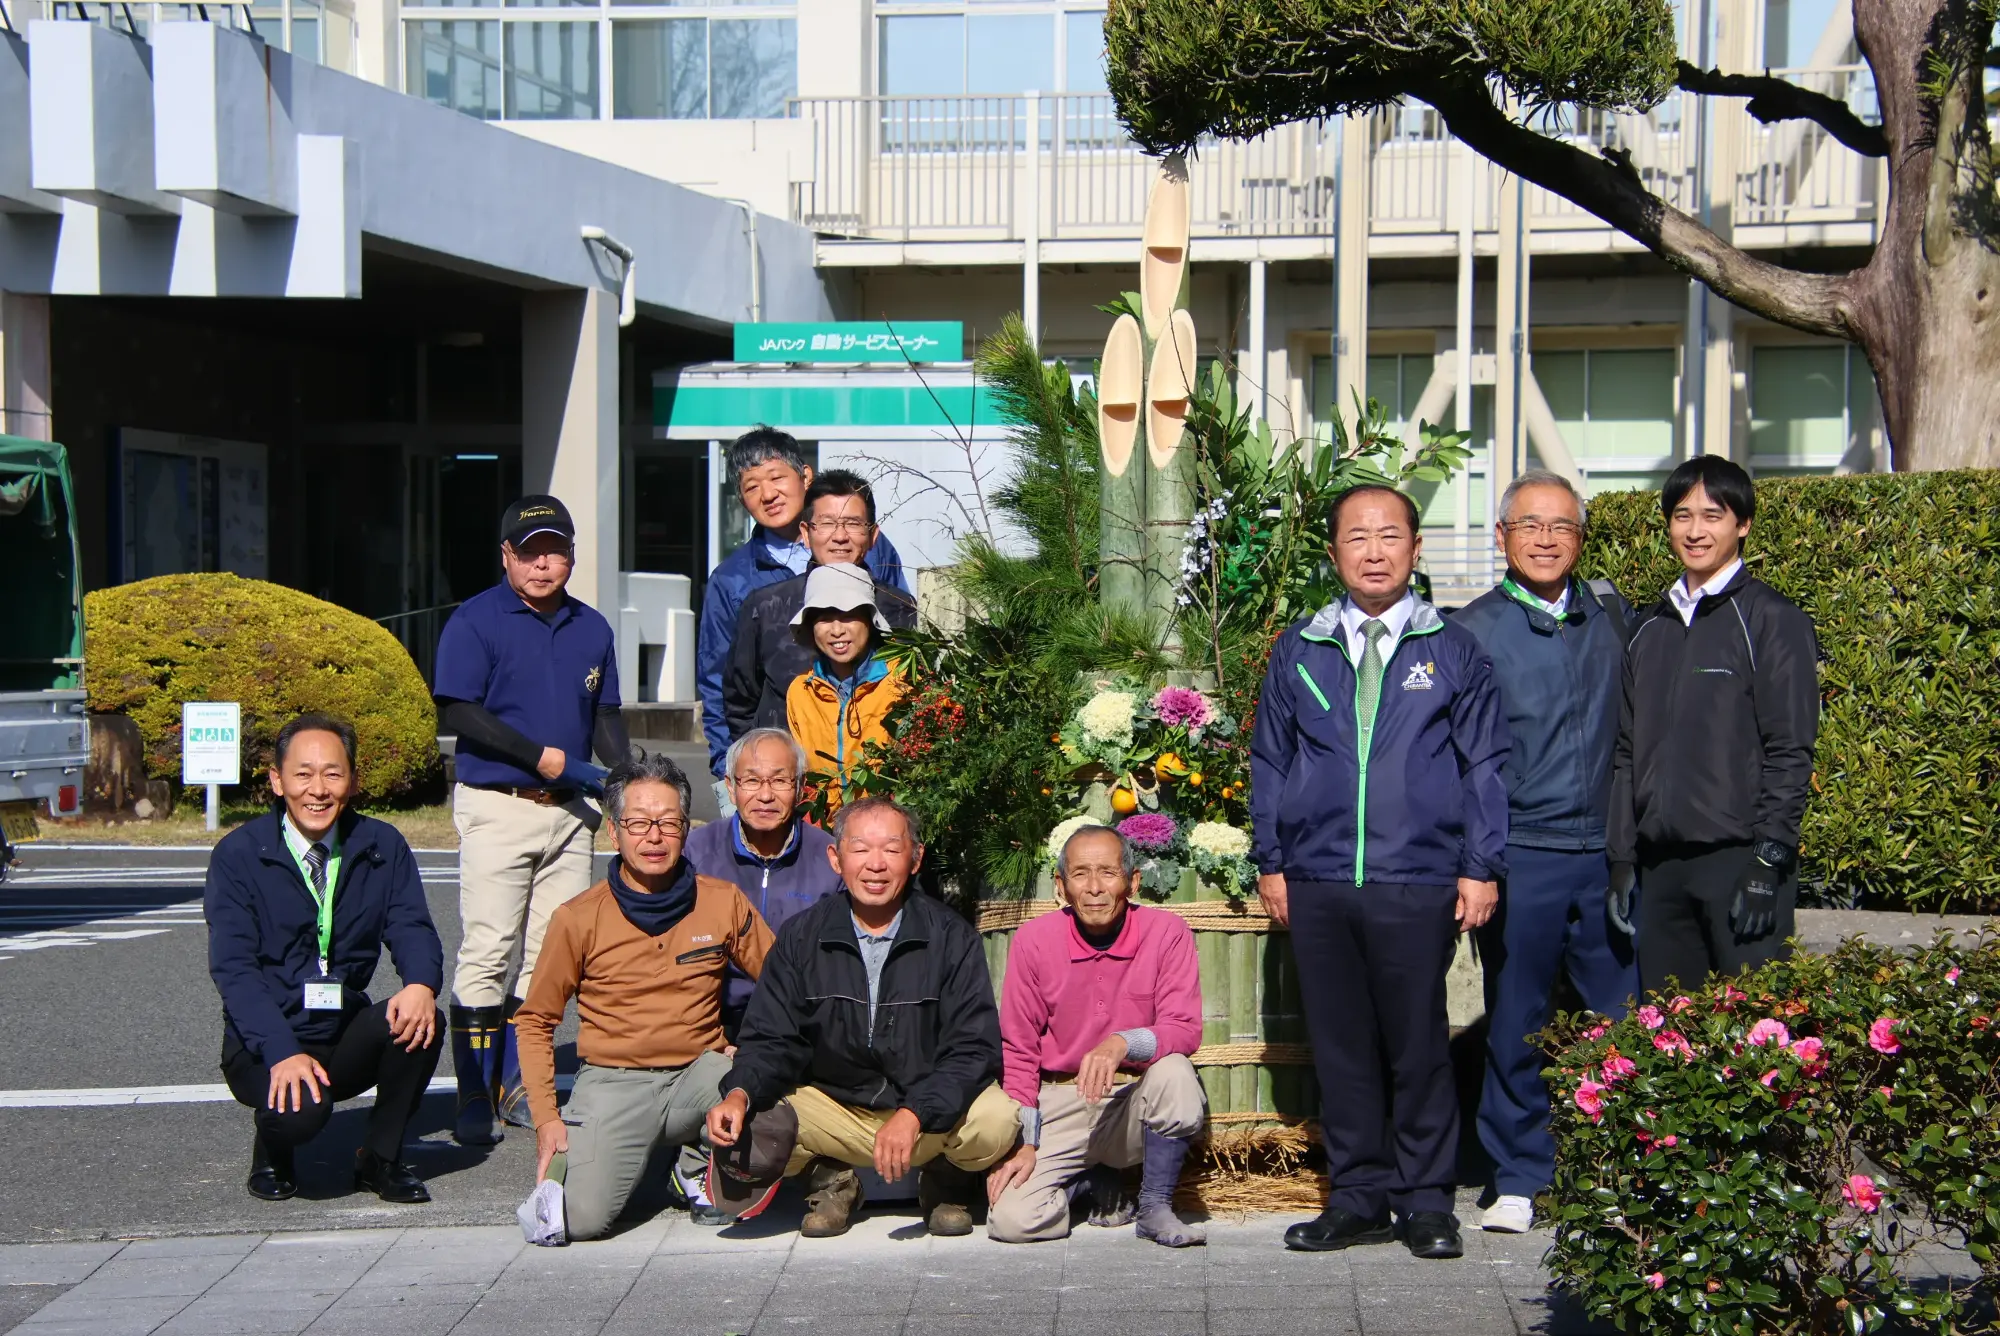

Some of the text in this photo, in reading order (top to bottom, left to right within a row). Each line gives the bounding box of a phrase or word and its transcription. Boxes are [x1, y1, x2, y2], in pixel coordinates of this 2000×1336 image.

[758, 334, 939, 351] JAバンク 自動サービスコーナー
